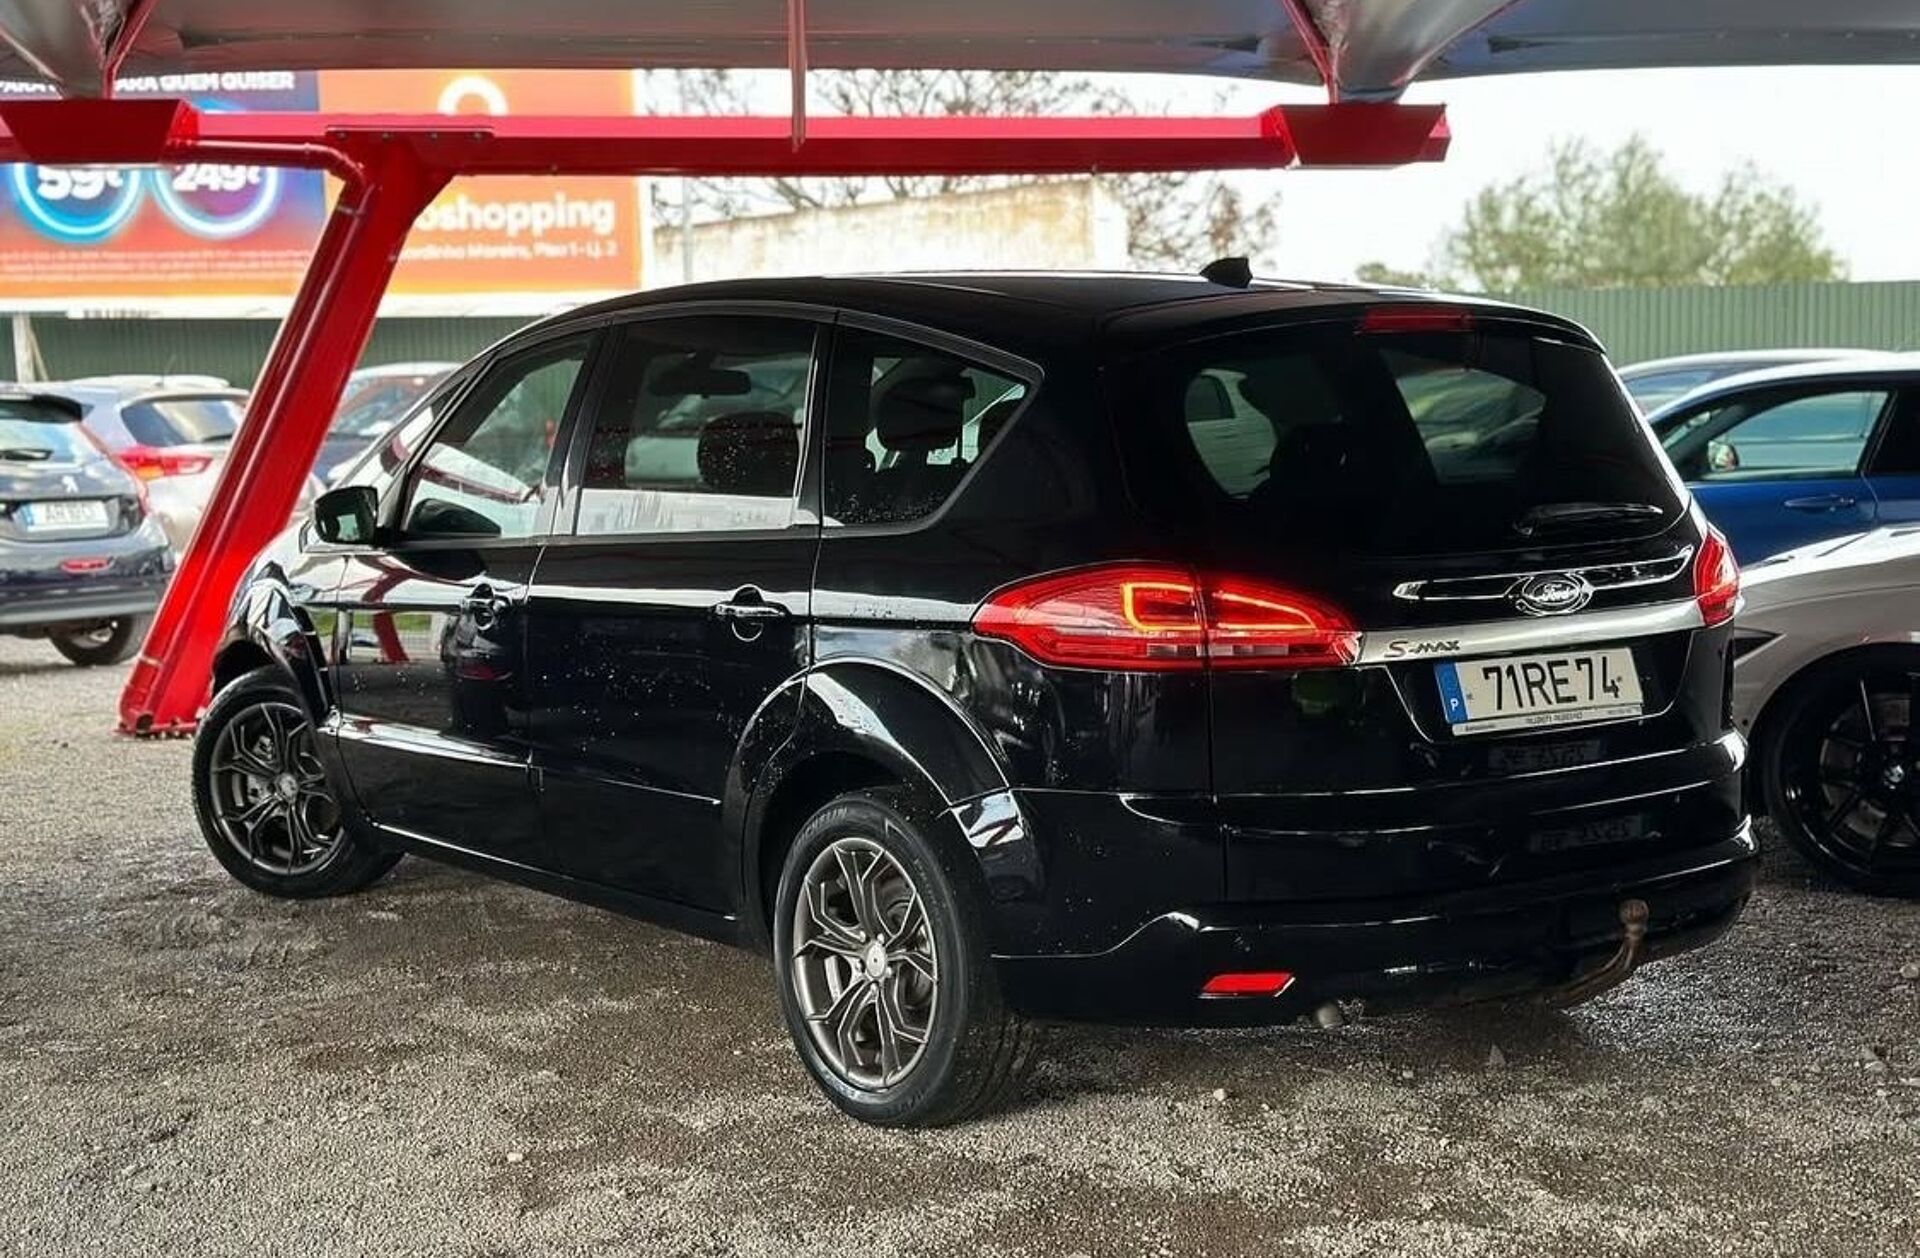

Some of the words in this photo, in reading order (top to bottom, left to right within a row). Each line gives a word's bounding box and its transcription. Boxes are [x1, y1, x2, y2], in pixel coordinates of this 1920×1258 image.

[159, 73, 219, 91] QUEM
[415, 193, 614, 235] oshopping
[1450, 698, 1459, 711] P
